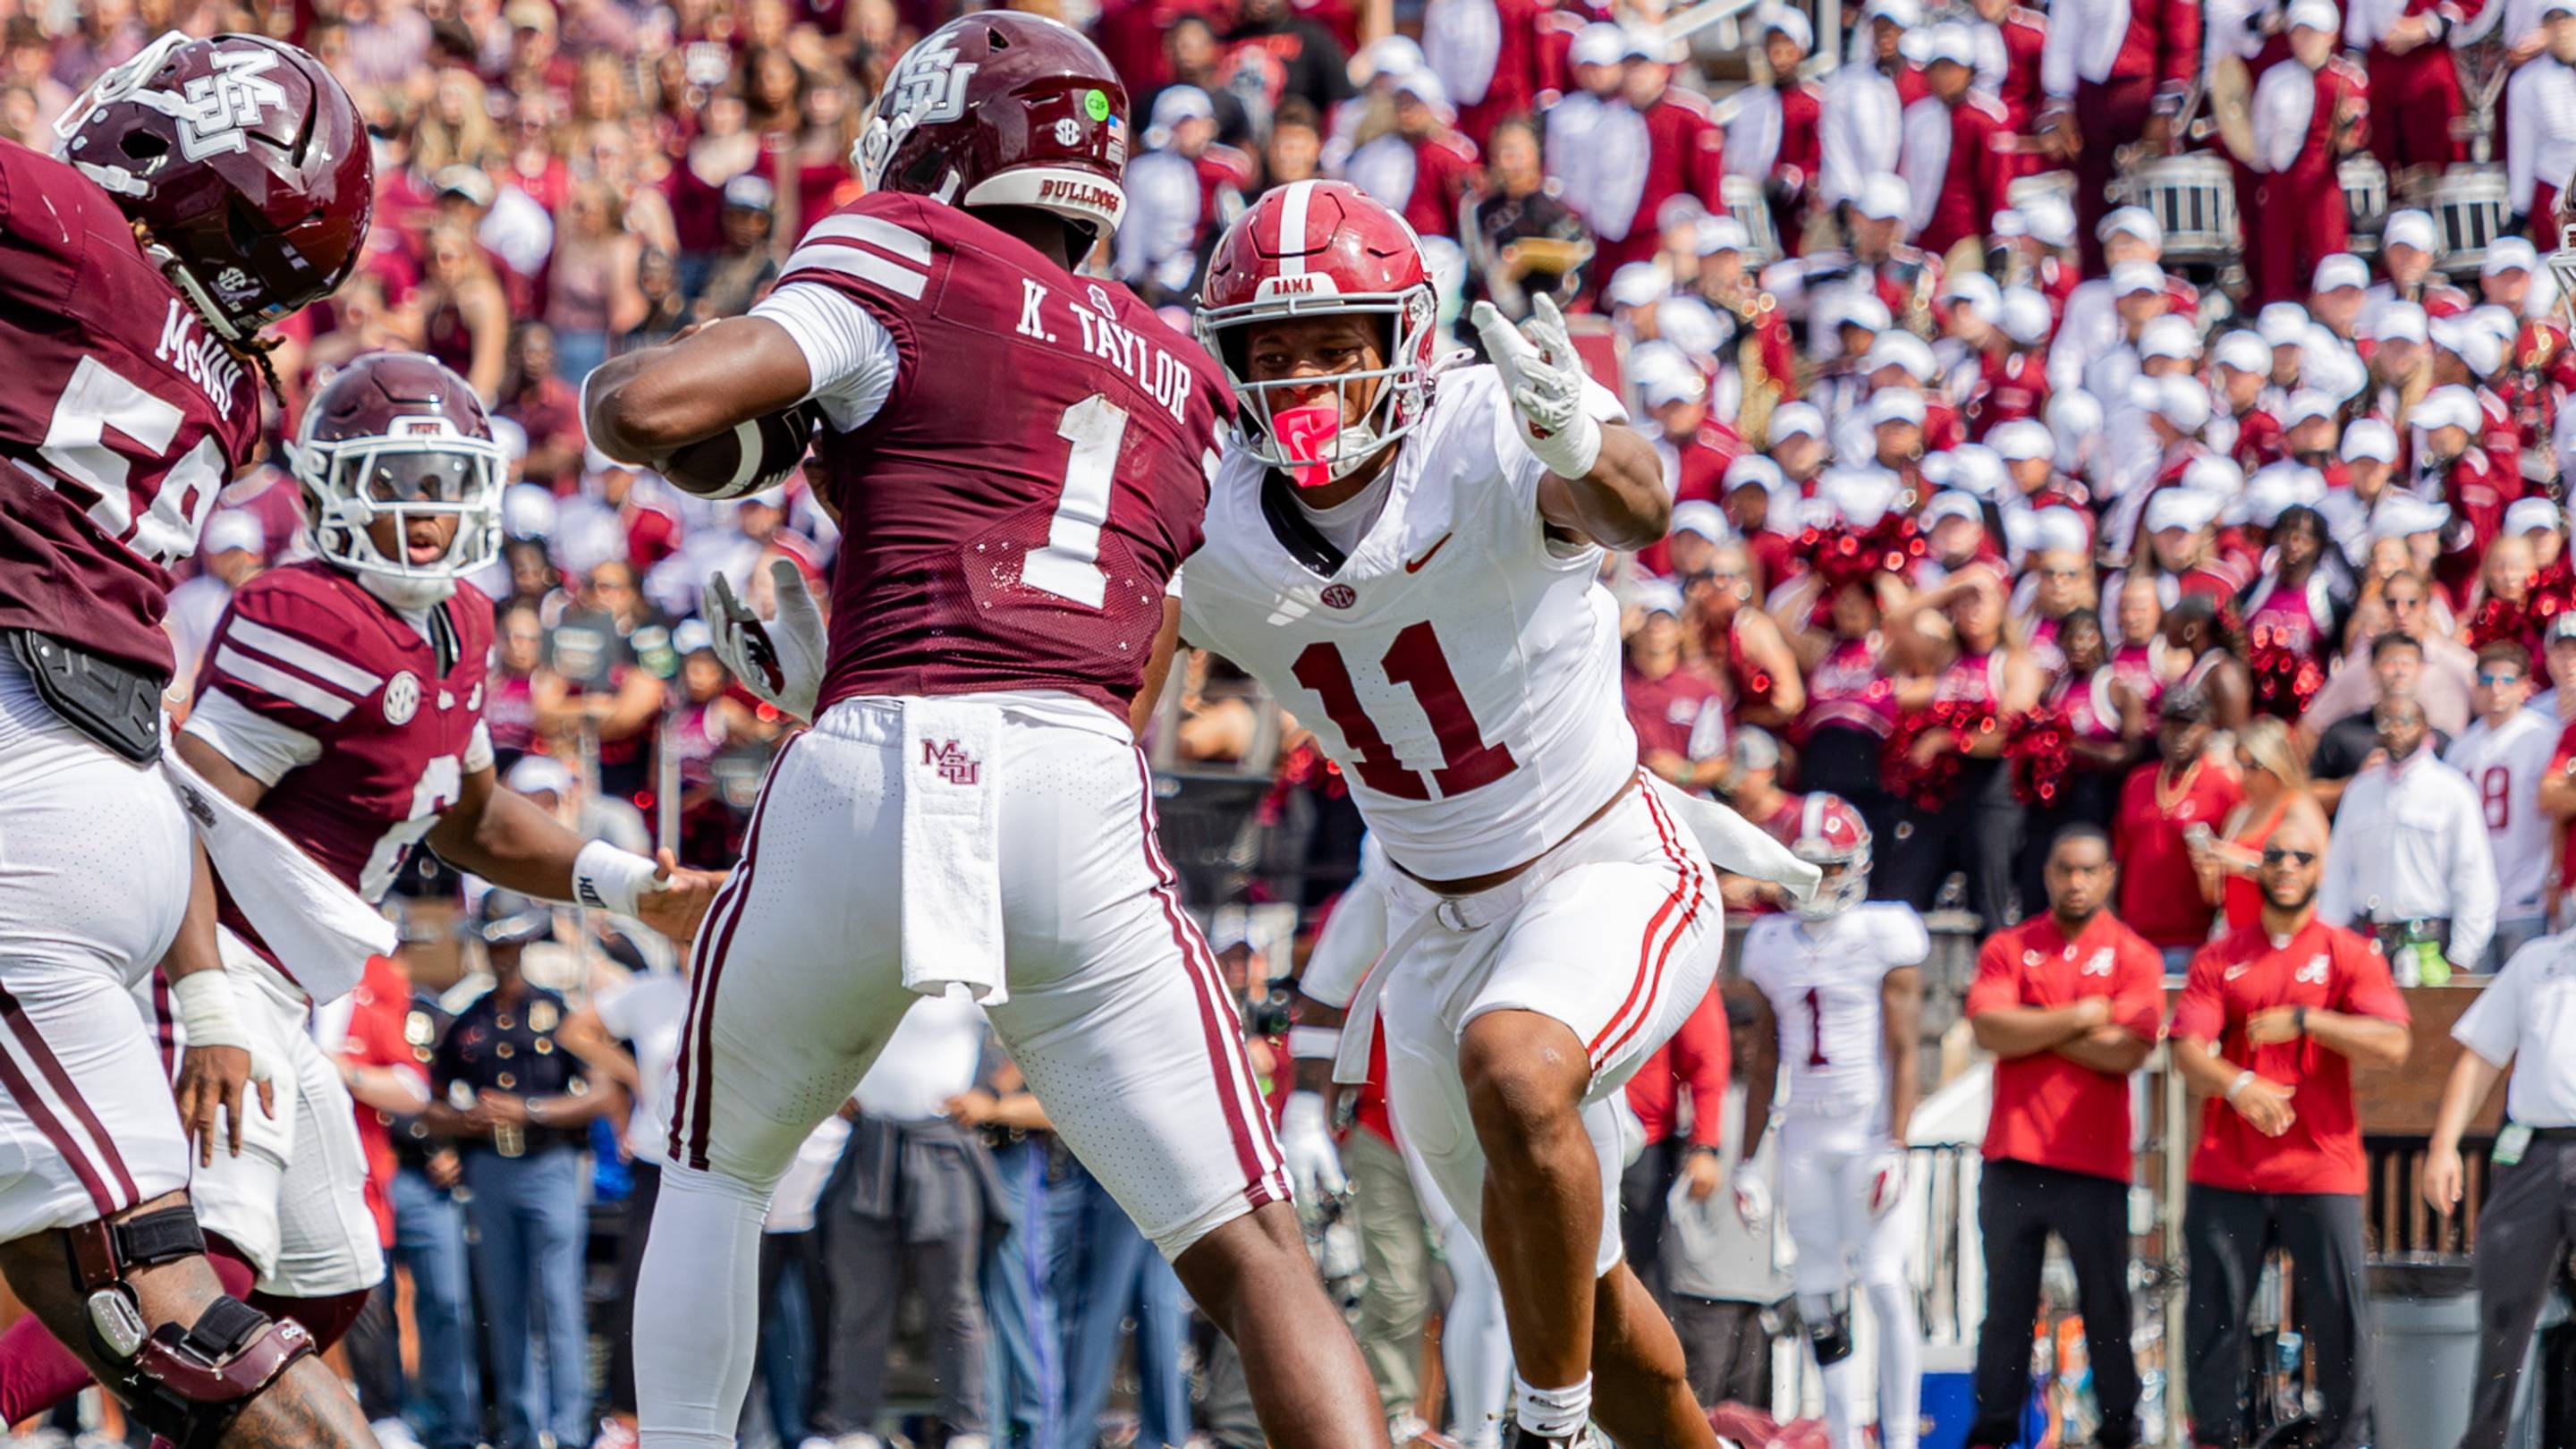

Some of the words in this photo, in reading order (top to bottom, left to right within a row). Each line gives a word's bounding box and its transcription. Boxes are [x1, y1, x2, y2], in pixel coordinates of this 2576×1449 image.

[175, 48, 288, 163] MSU
[1055, 118, 1080, 147] SEC
[217, 267, 247, 291] SEC
[1272, 277, 1314, 295] BAMA
[1016, 278, 1057, 343] K.
[1069, 301, 1191, 425] TAYLOR
[1021, 393, 1131, 609] 1
[1320, 584, 1357, 609] SEC
[1291, 620, 1520, 801] 11
[919, 739, 981, 784] MSU
[2465, 766, 2510, 833] 8
[1801, 987, 1829, 1066] 1
